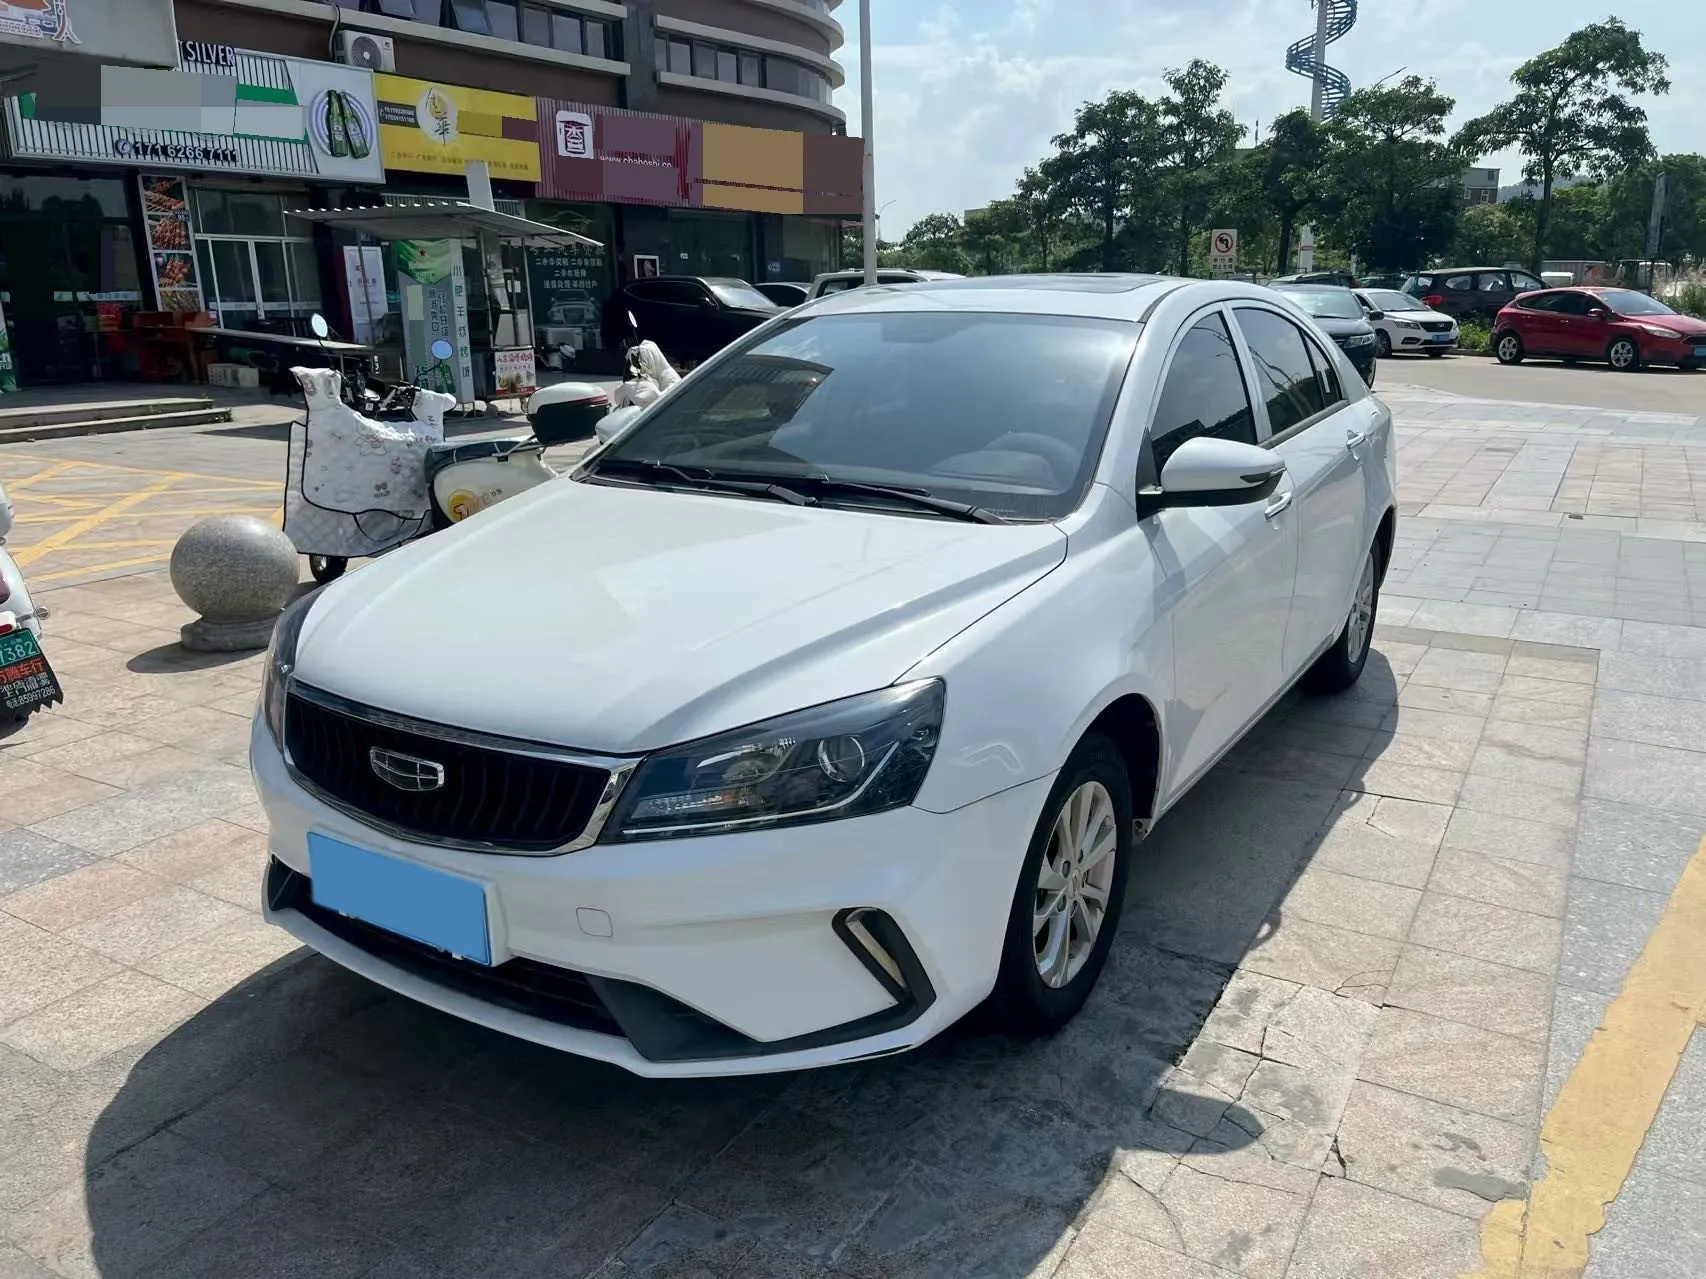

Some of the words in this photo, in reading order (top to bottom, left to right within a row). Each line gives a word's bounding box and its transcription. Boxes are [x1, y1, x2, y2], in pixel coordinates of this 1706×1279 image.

[186, 41, 236, 67] SILVER
[136, 141, 162, 155] 171
[167, 144, 204, 159] 6266
